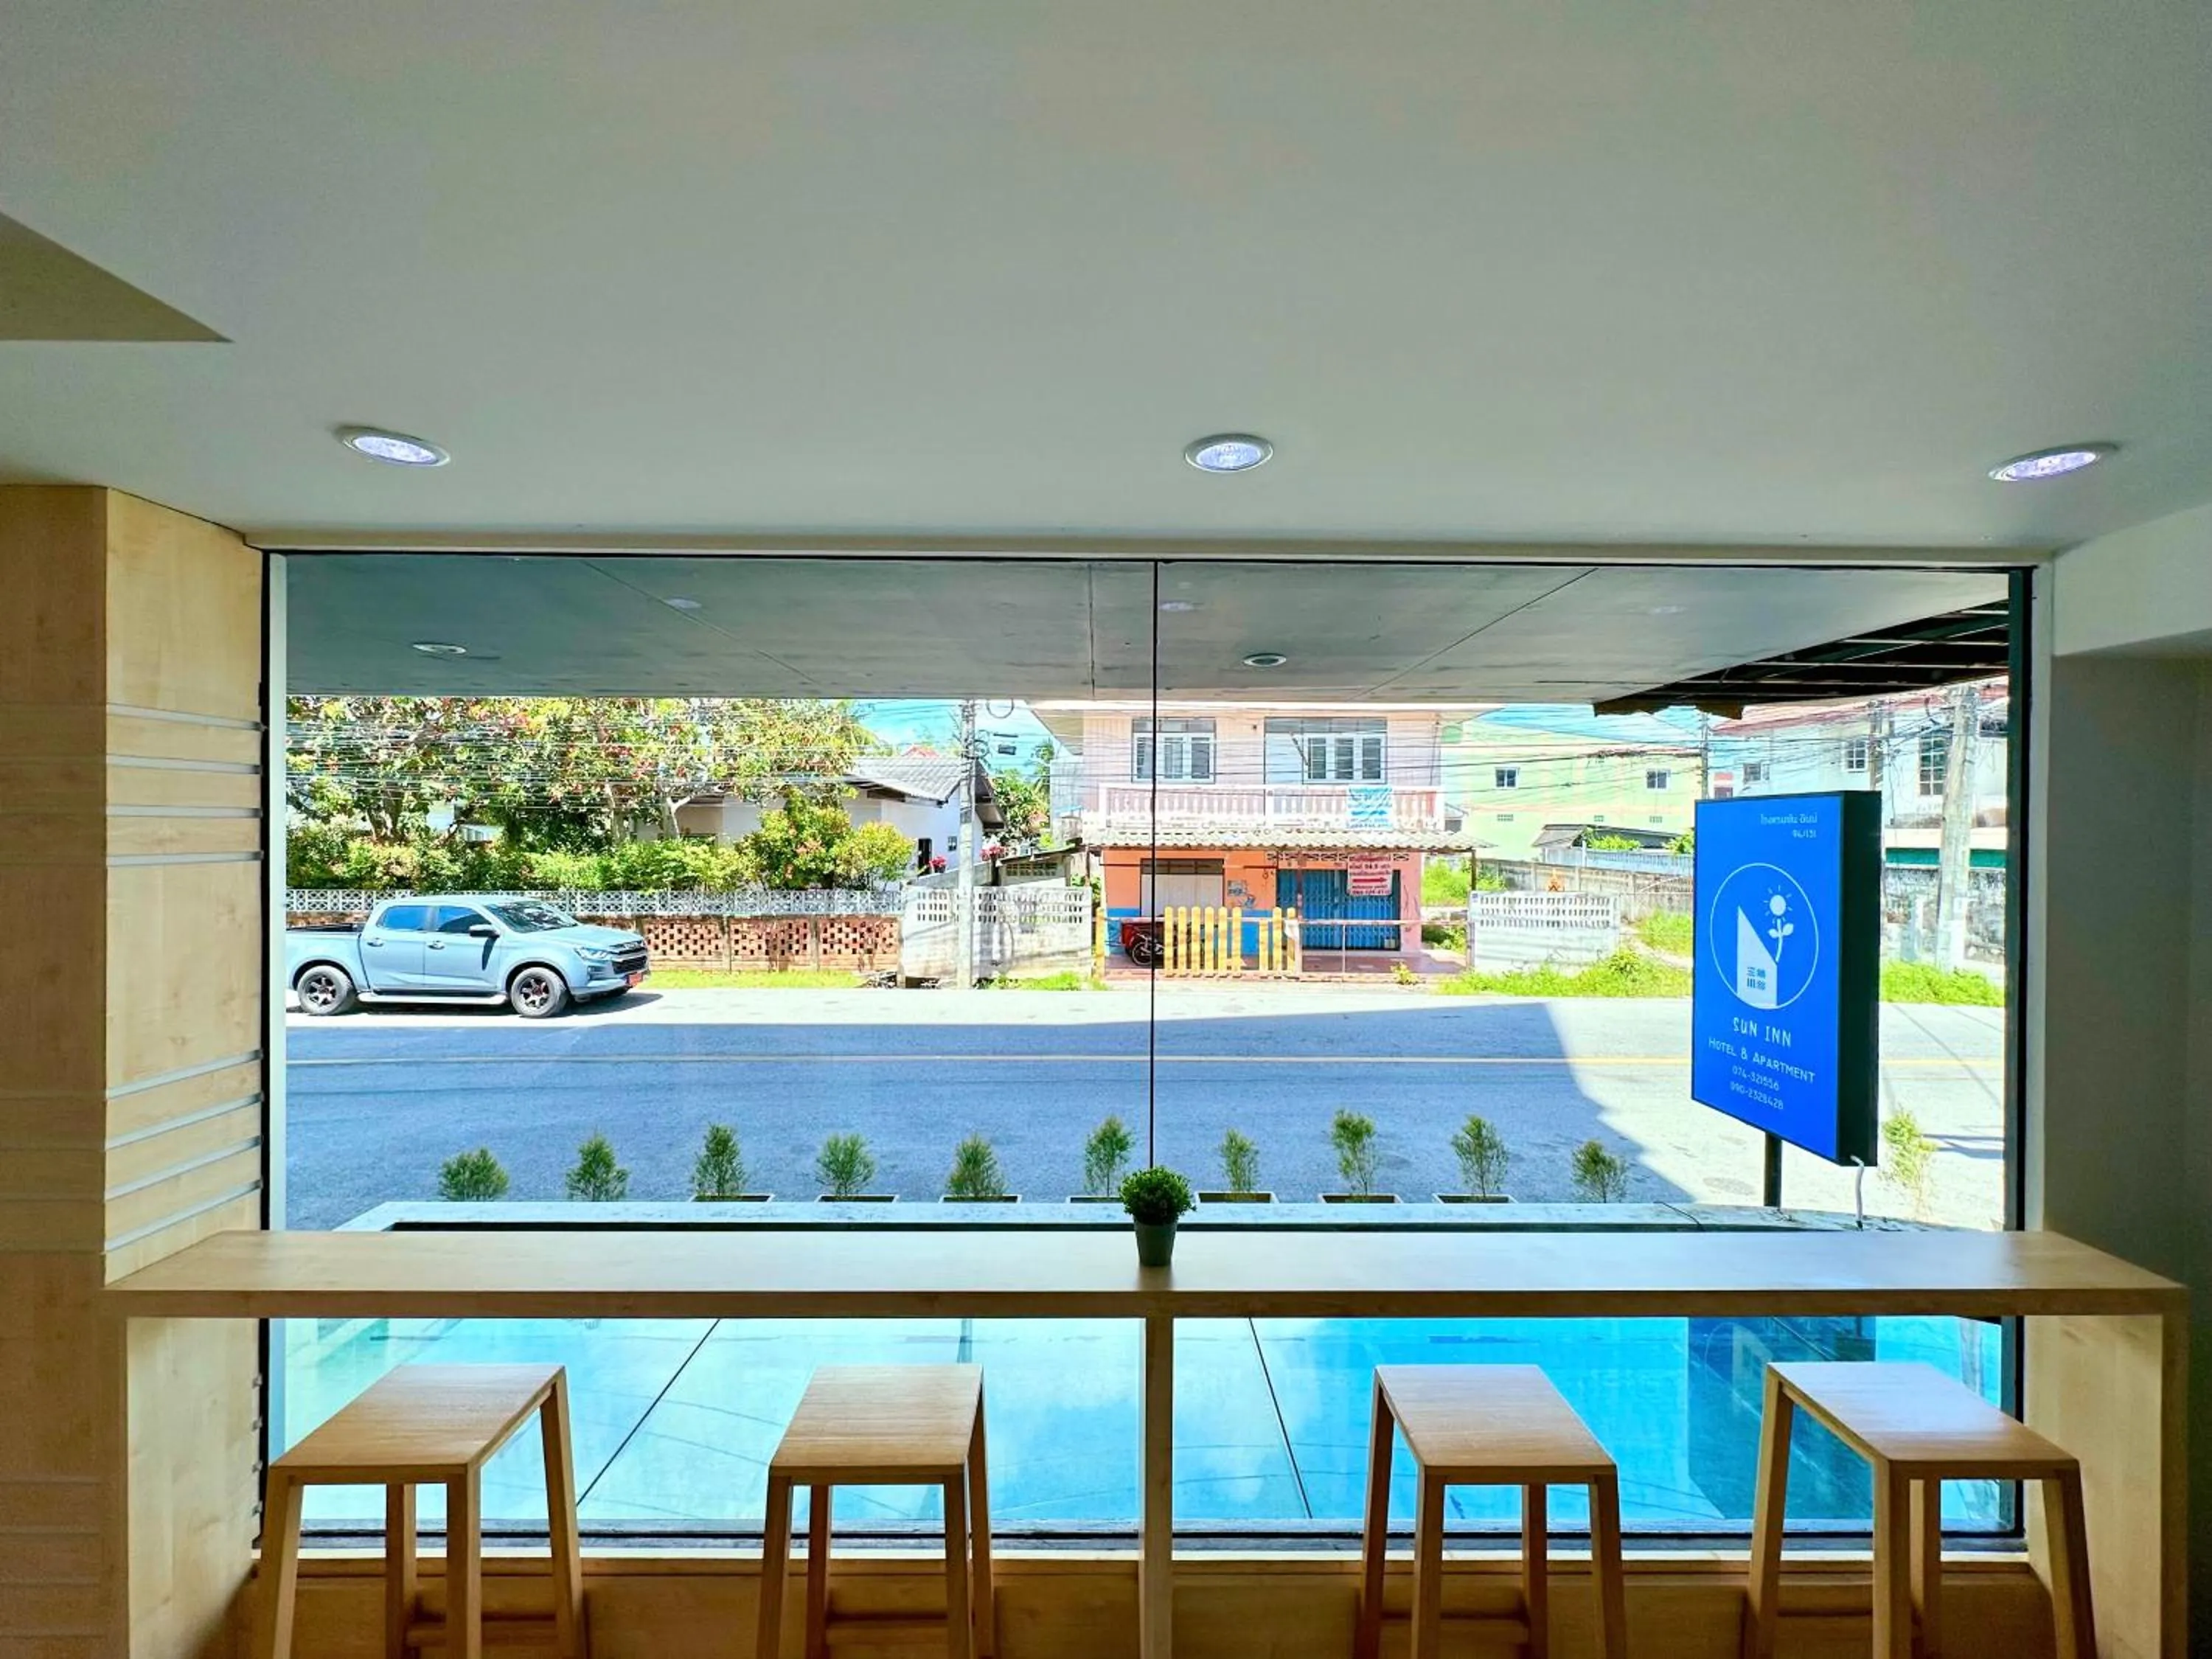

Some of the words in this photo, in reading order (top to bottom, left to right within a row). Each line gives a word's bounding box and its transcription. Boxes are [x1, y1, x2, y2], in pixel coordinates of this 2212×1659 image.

[1733, 1017, 1757, 1037] SUN
[1764, 1026, 1792, 1048] INN
[1708, 1037, 1737, 1057] HOTEL
[1753, 1052, 1815, 1083] APARTMENT
